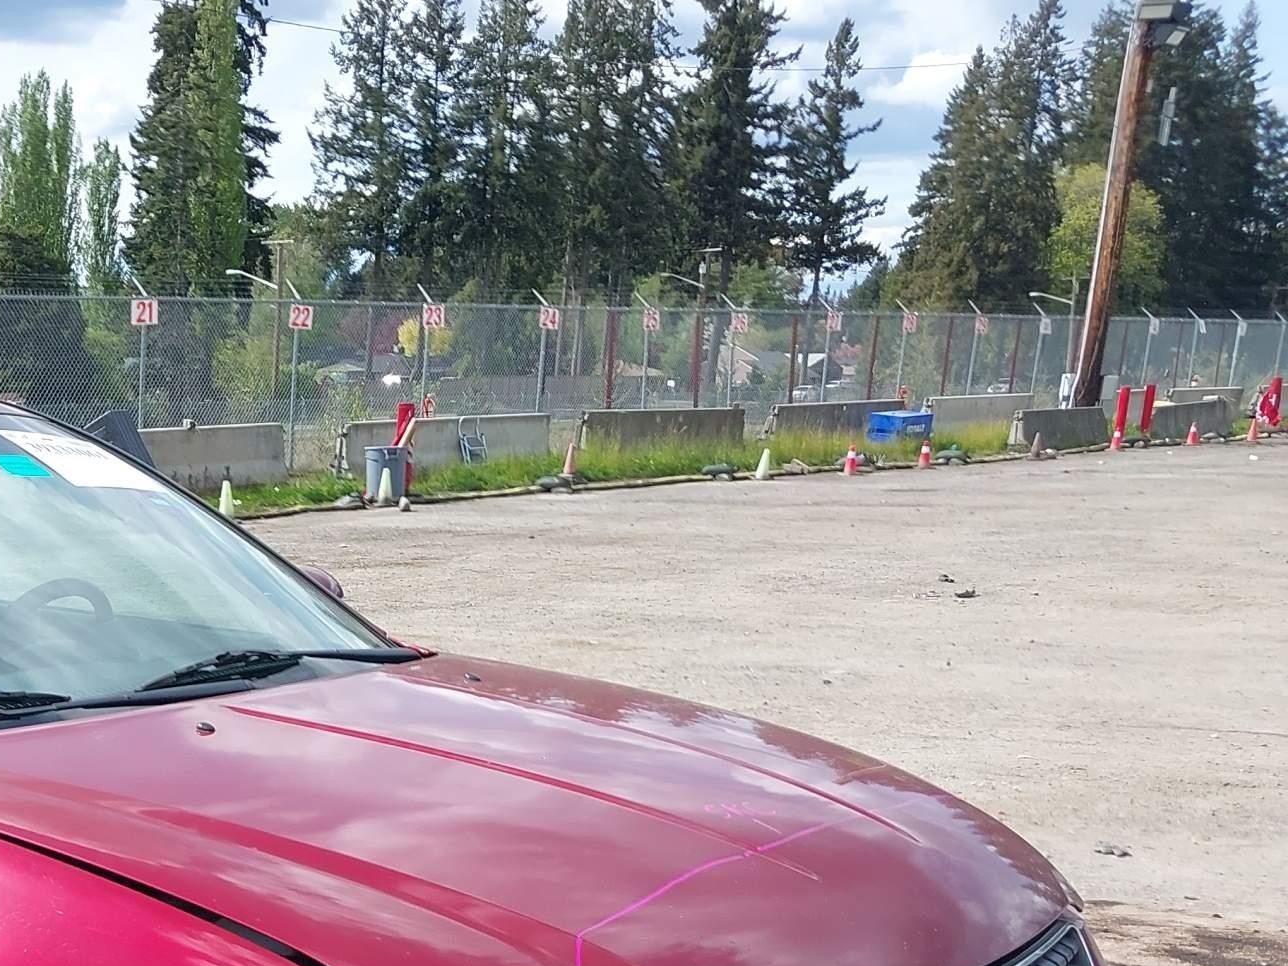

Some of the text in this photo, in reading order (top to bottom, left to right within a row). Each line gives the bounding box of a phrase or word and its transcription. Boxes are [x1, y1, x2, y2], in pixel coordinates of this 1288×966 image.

[135, 301, 155, 324] 21
[291, 306, 313, 328] 22
[424, 306, 443, 327] 23
[542, 309, 558, 326] 24
